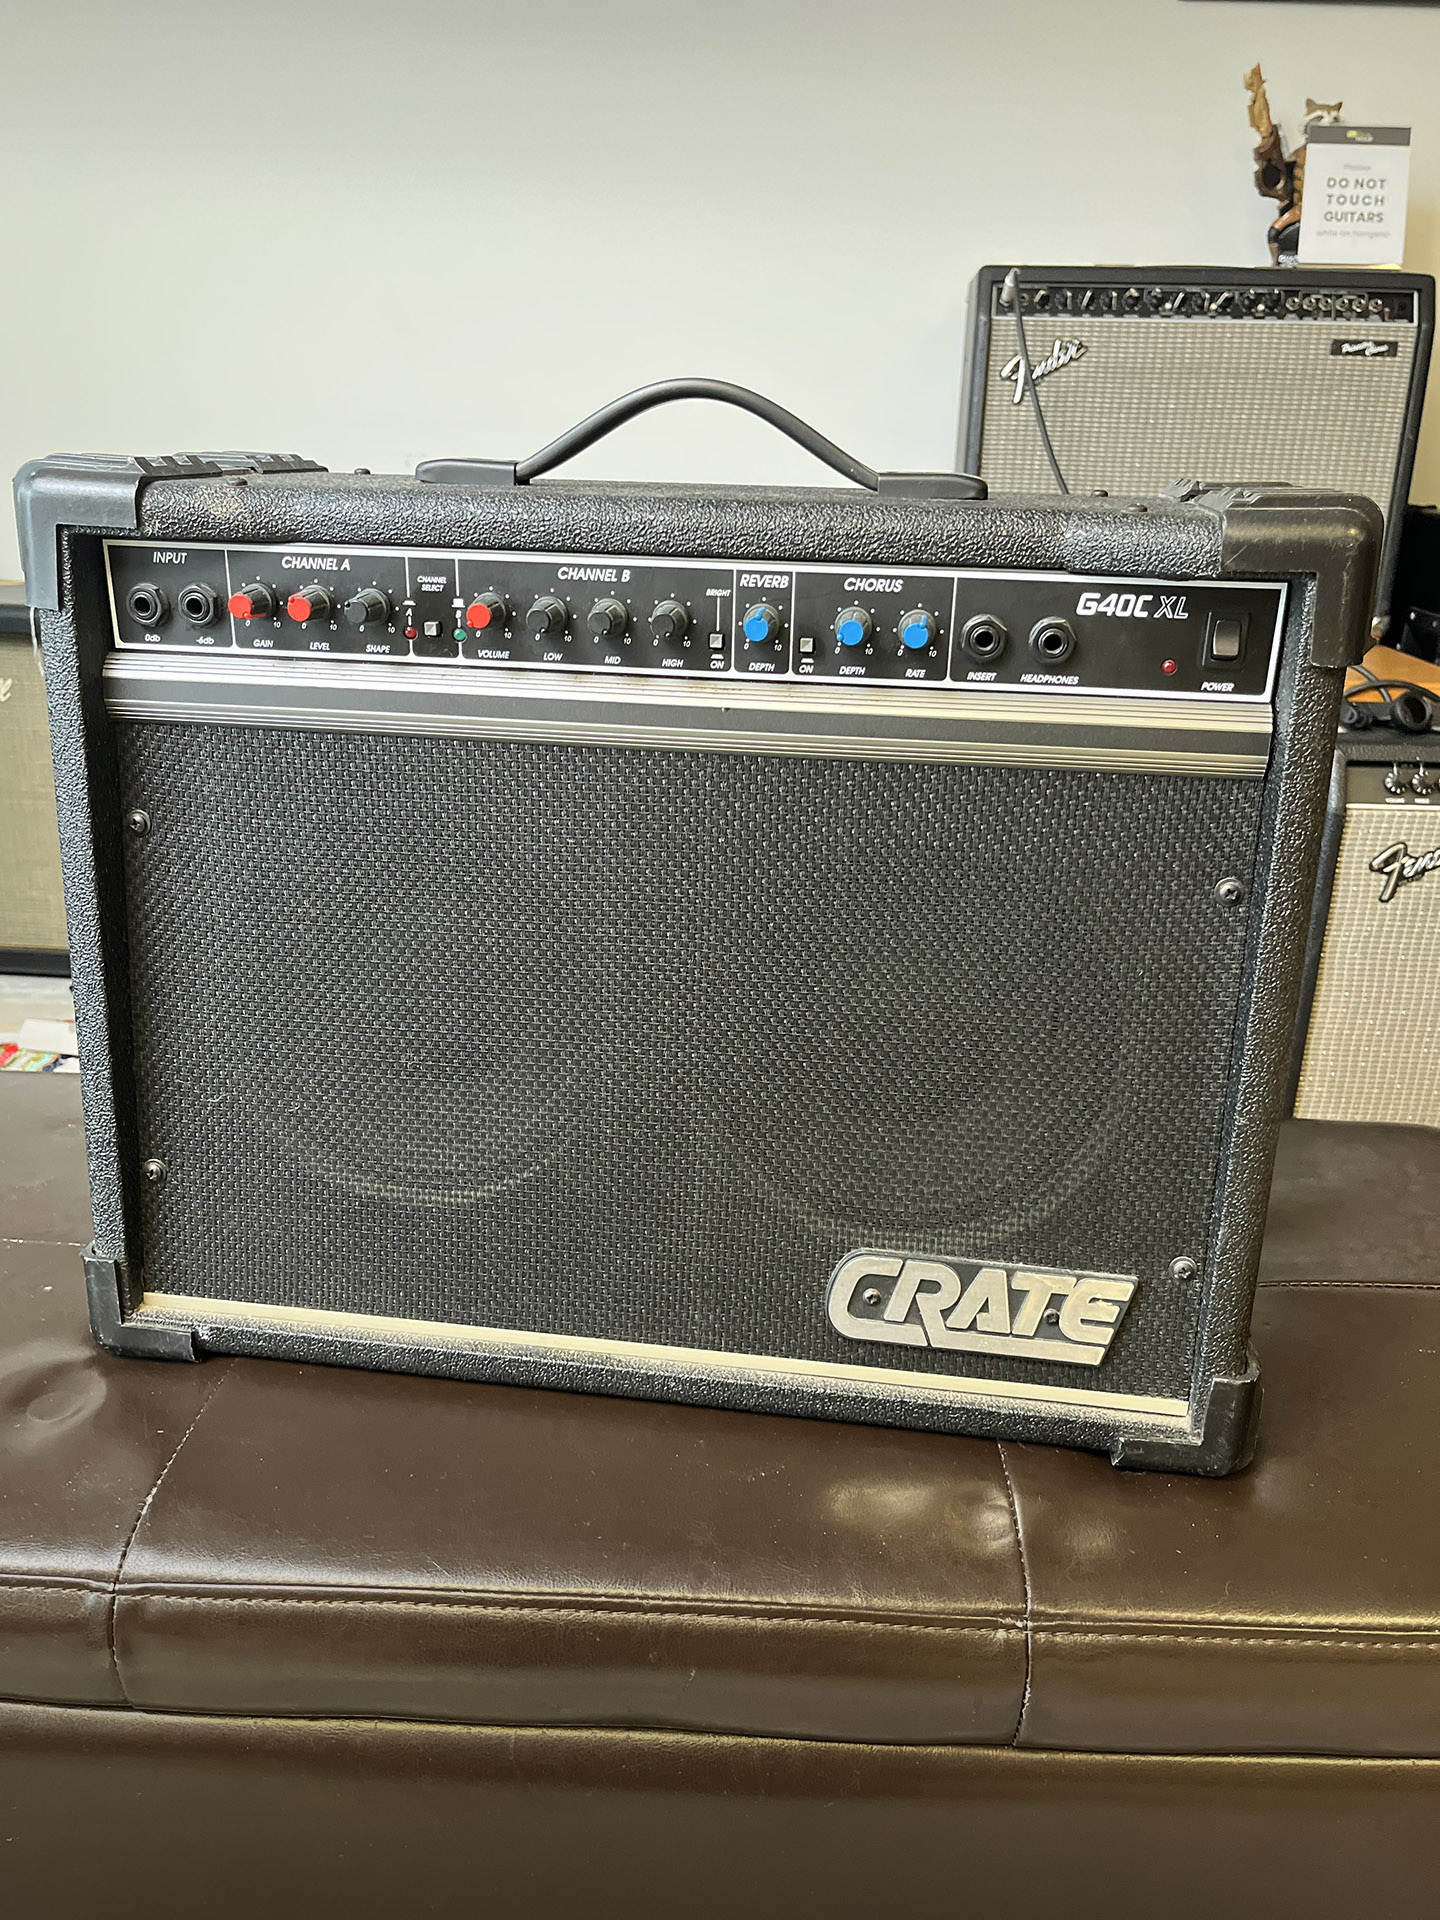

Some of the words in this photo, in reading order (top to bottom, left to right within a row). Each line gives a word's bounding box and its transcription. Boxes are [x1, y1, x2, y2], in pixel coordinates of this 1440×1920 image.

[1326, 177, 1349, 189] DO
[1354, 178, 1387, 190] NOT
[1326, 194, 1385, 206] TOUCH
[1323, 211, 1384, 223] GUITARS
[1000, 338, 1088, 405] Fnder
[152, 551, 188, 565] INPUT
[281, 556, 338, 571] CHANNEL
[340, 559, 351, 571] A
[416, 575, 448, 584] CHANNEL
[557, 567, 618, 582] CHANNEL
[621, 569, 631, 583] B
[739, 574, 790, 589] REVERB
[843, 577, 904, 593] CHORUS
[421, 584, 444, 592] SELECT
[705, 588, 732, 597] BRIGHT
[1075, 592, 1154, 618] G40C
[1153, 595, 1189, 619] XL
[405, 607, 413, 617] A
[455, 609, 462, 619] B
[144, 633, 161, 642] 0db
[475, 630, 481, 638] 0
[504, 631, 512, 639] 10
[535, 633, 541, 641] 0
[195, 636, 215, 645] -6db
[253, 639, 274, 648] GAIN
[593, 636, 599, 644] 0
[623, 637, 632, 645] 10
[653, 639, 659, 647] 0
[683, 640, 691, 648] 10
[309, 641, 331, 651] LEVEL
[365, 644, 391, 653] SHAPE
[743, 642, 750, 650] 0
[834, 646, 840, 654] 0
[865, 647, 873, 655] 10
[477, 649, 511, 659] VOLUME
[543, 652, 563, 661] LOW
[897, 648, 904, 656] 0
[604, 655, 621, 664] MID
[661, 658, 684, 668] HIGH
[710, 660, 725, 669] ON
[748, 662, 775, 672] DEPTH
[798, 664, 814, 674] ON
[839, 665, 866, 675] DEPTH
[905, 668, 926, 678] RATE
[966, 671, 997, 681] INSERT
[1020, 673, 1080, 685] HEADPHONES
[1200, 681, 1235, 692] POWER
[827, 1255, 1136, 1366] CRATE
